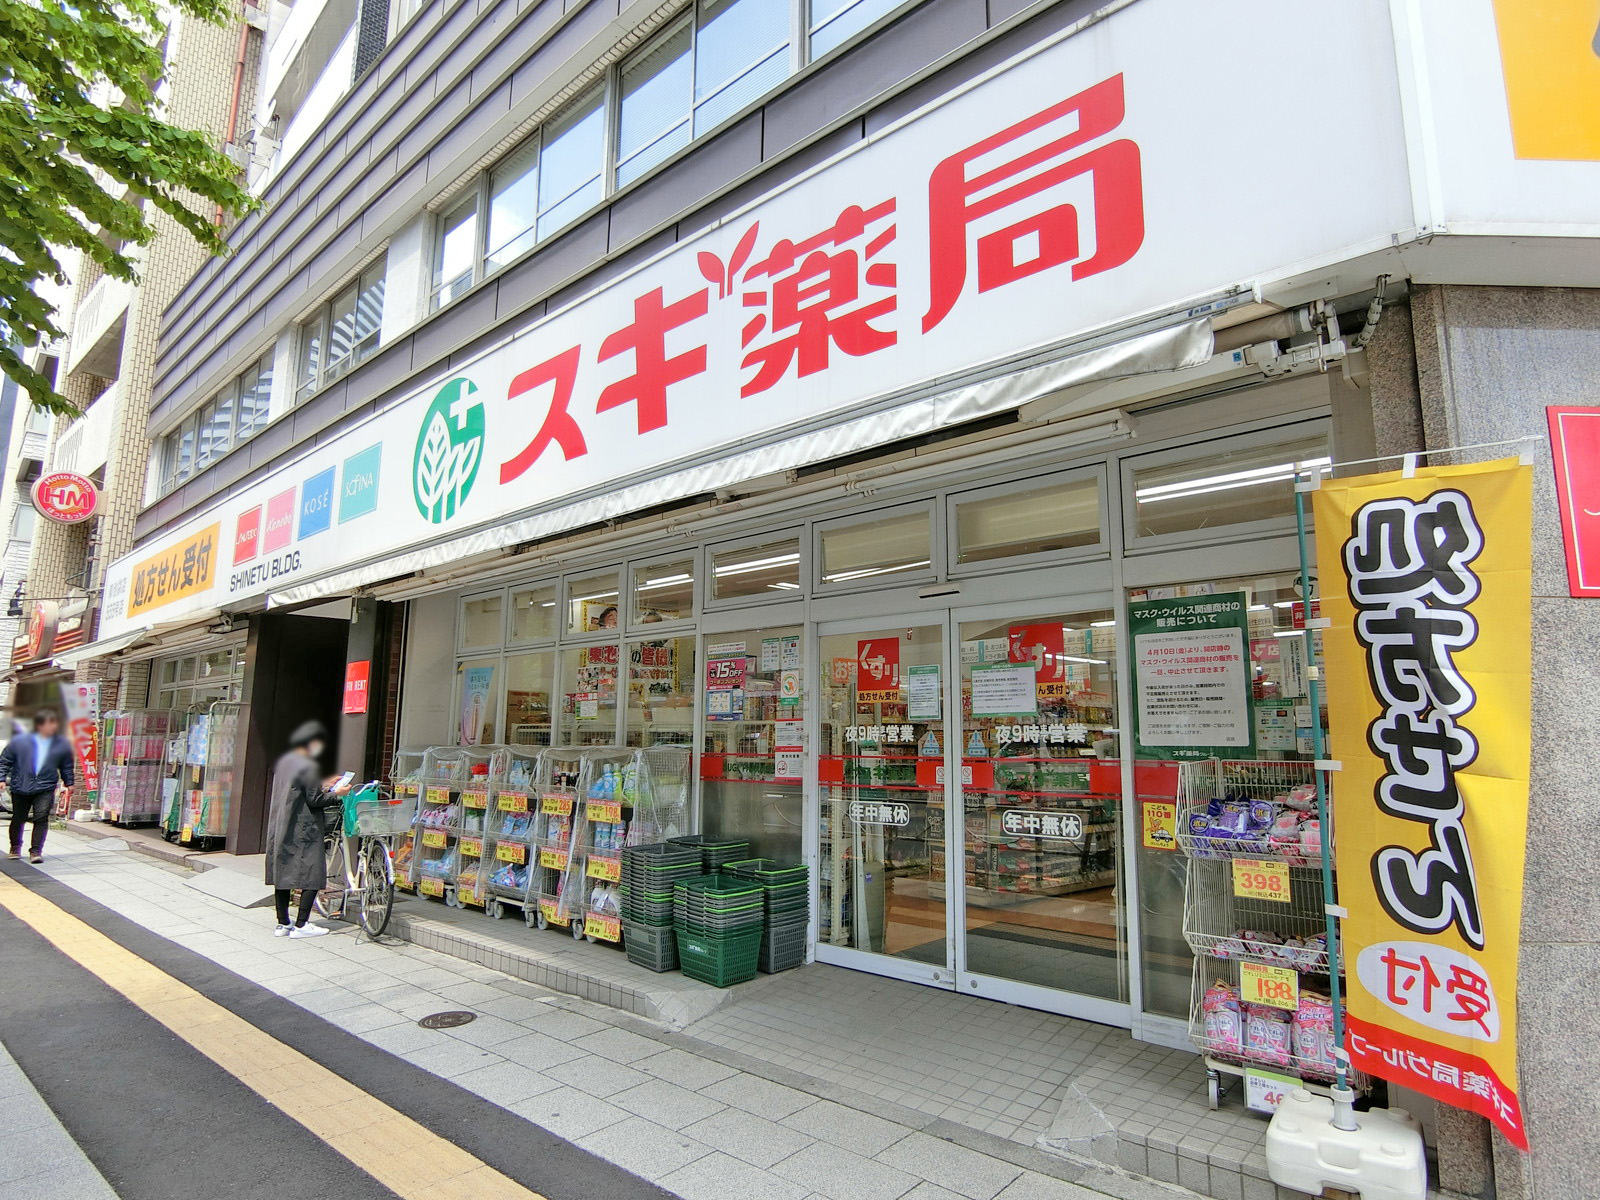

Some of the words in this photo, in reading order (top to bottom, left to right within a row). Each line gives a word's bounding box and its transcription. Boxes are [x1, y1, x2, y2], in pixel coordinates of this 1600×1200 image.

[500, 71, 1146, 486] スギ薬局
[44, 474, 69, 485] Hotto
[70, 475, 92, 493] Motto
[44, 487, 90, 510] HM
[266, 513, 292, 534] Kanebo
[132, 534, 212, 609] 処方せん受付
[229, 560, 270, 593] SHINETU
[271, 550, 302, 579] BLDG.
[1133, 601, 1240, 619] マスク・ウイルス関連商材の
[1156, 613, 1217, 628] 販売について
[859, 642, 899, 687] くすり
[858, 691, 898, 702] 処方せん受付
[851, 803, 908, 824] 年中無休
[1005, 813, 1080, 837] 年中無休
[1240, 872, 1282, 892] 398
[1257, 978, 1294, 1001] 188
